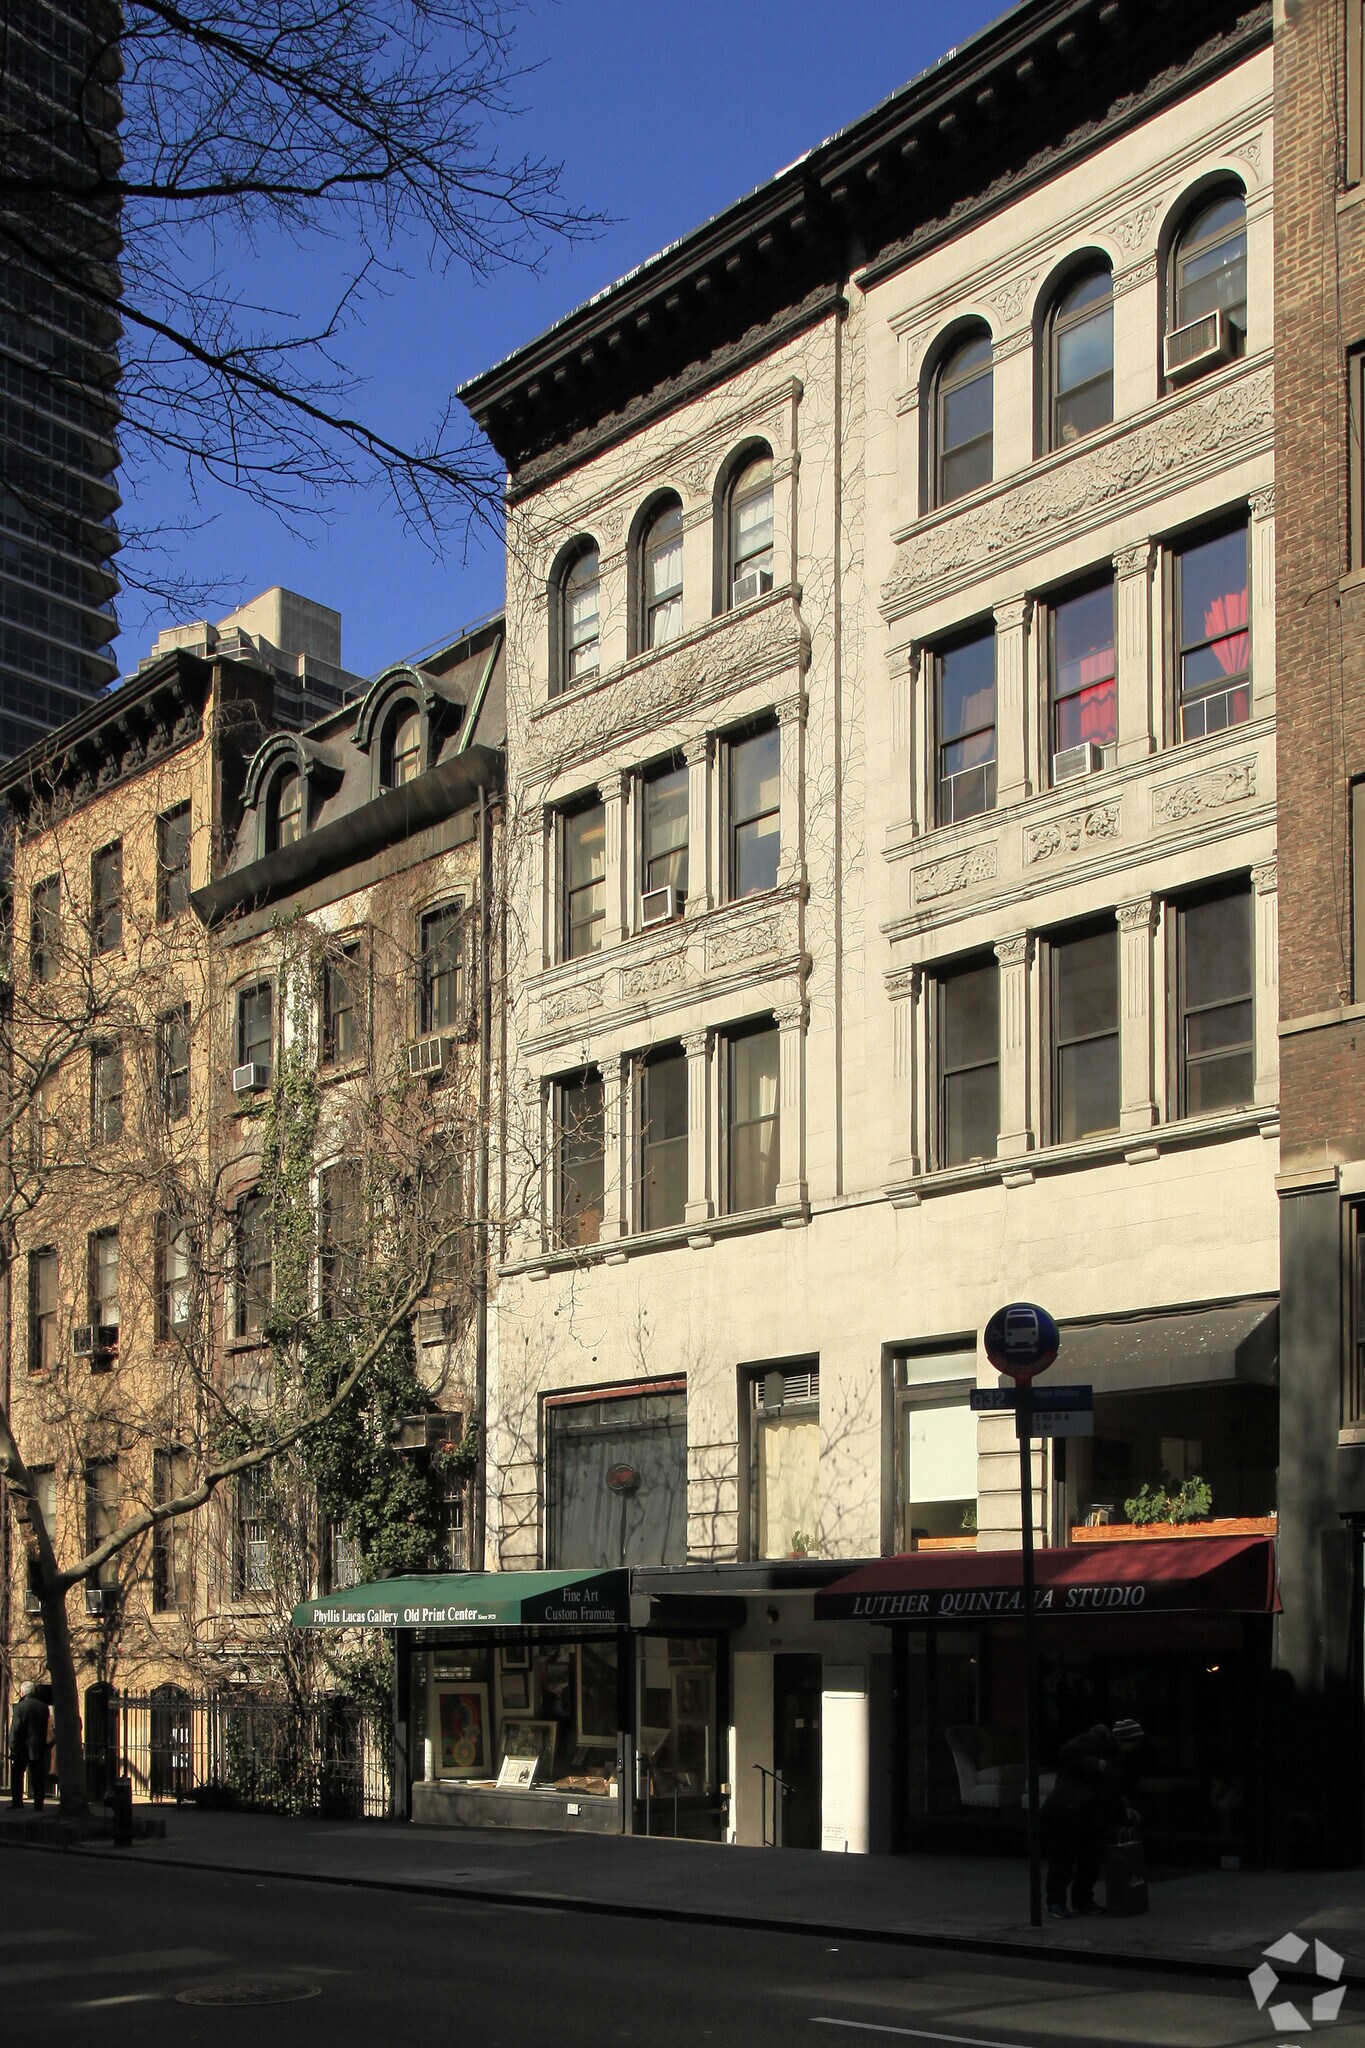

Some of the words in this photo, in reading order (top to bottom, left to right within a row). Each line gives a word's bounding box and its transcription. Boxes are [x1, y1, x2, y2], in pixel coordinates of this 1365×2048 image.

[563, 1588, 581, 1602] Fine
[583, 1588, 599, 1602] Art
[852, 1594, 930, 1615] LUTHER
[938, 1589, 1054, 1616] QUINTAA
[1065, 1585, 1146, 1608] STUDIO
[313, 1609, 340, 1625] Phyllis
[342, 1609, 366, 1623] Lucas
[367, 1609, 399, 1626] Gallery
[403, 1608, 420, 1622] Old
[422, 1607, 446, 1622] Print
[447, 1606, 478, 1621] Center
[545, 1606, 578, 1621] Custom
[580, 1605, 615, 1622] Framing
